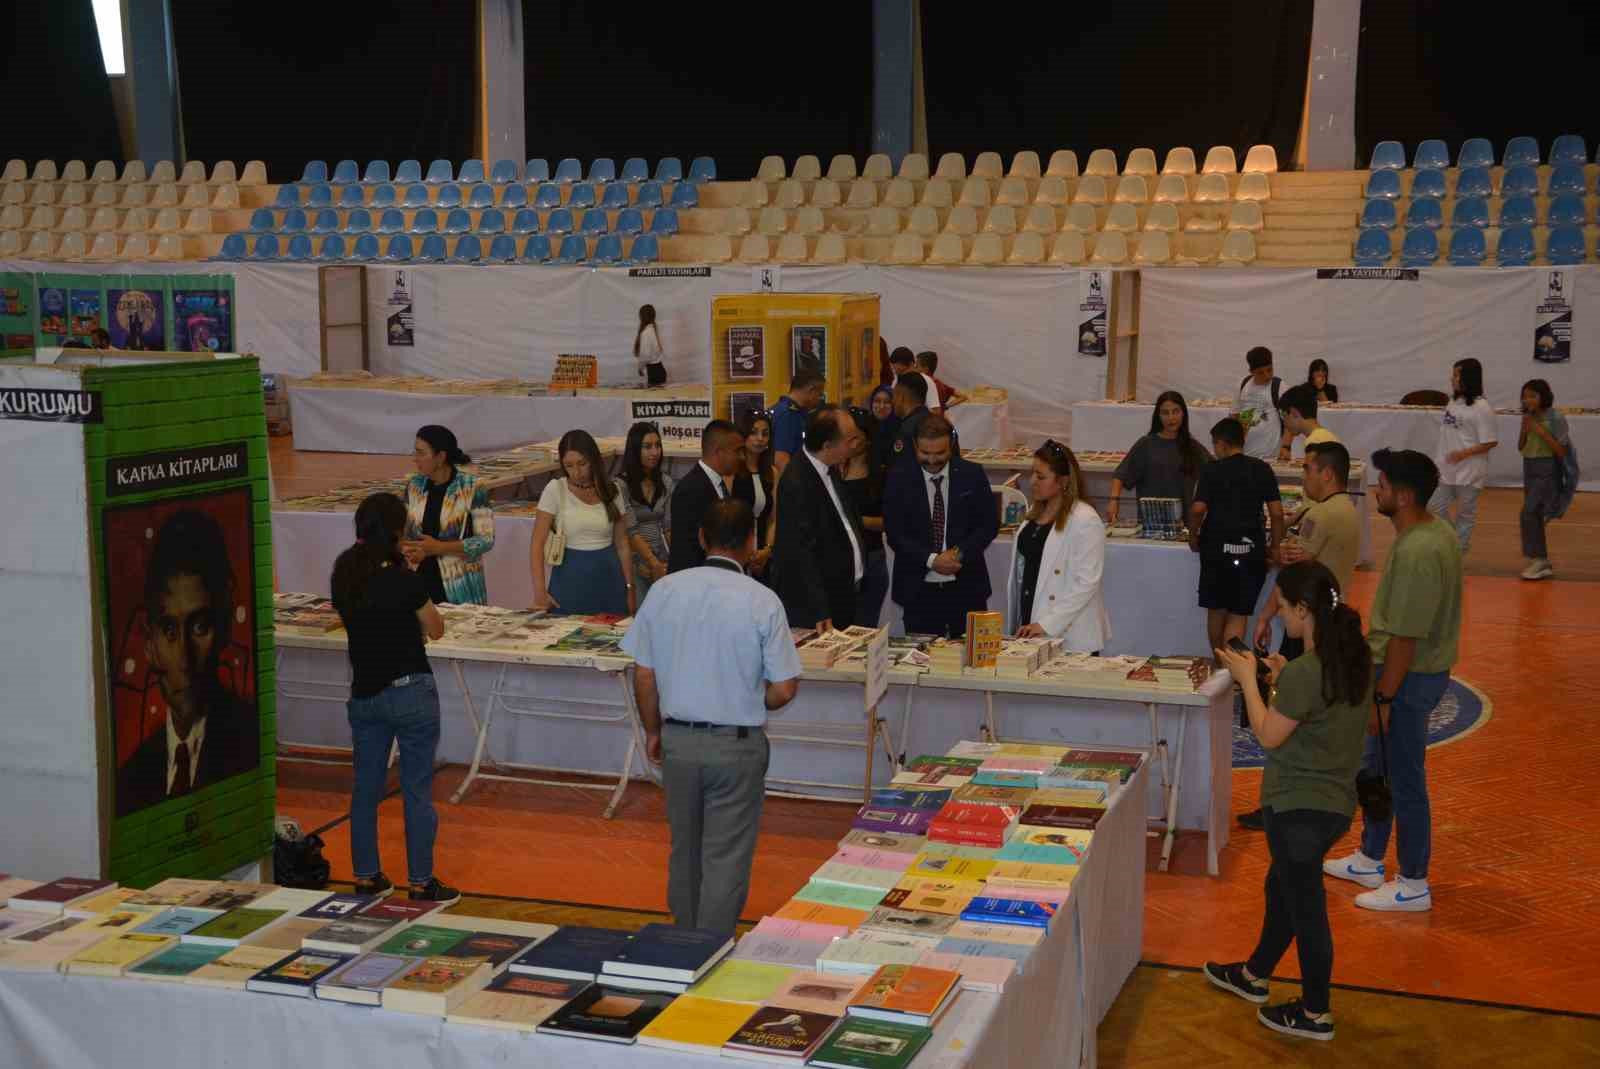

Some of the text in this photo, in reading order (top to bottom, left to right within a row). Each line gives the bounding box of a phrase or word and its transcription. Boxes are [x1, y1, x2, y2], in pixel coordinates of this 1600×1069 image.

[0, 391, 92, 416] KURUMU
[636, 404, 671, 416] KİTAP
[117, 453, 238, 485] KAFKA KİTAPLARI
